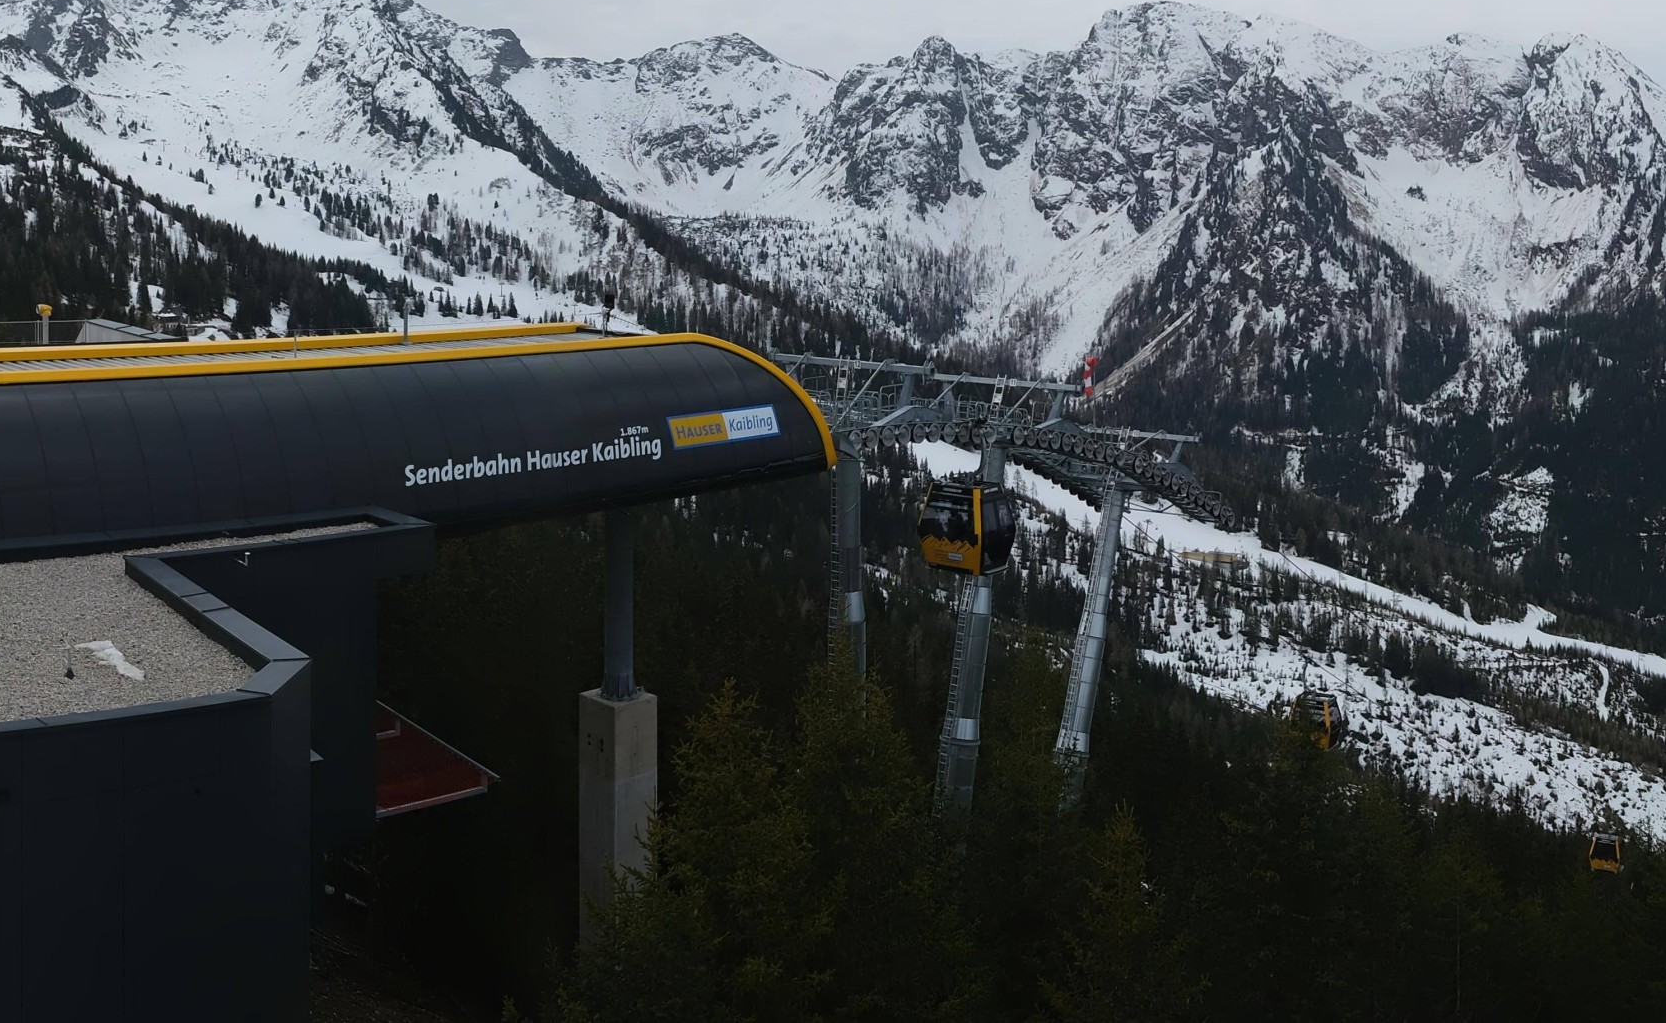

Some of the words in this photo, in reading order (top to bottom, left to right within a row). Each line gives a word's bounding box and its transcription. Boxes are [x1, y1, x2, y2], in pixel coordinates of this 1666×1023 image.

[620, 425, 649, 437] 1.867m
[675, 421, 723, 440] HAUSER
[728, 413, 773, 433] Kaibling
[404, 452, 522, 487] Senderbahn
[526, 446, 588, 470] Hauser
[592, 436, 662, 462] Kaibling
